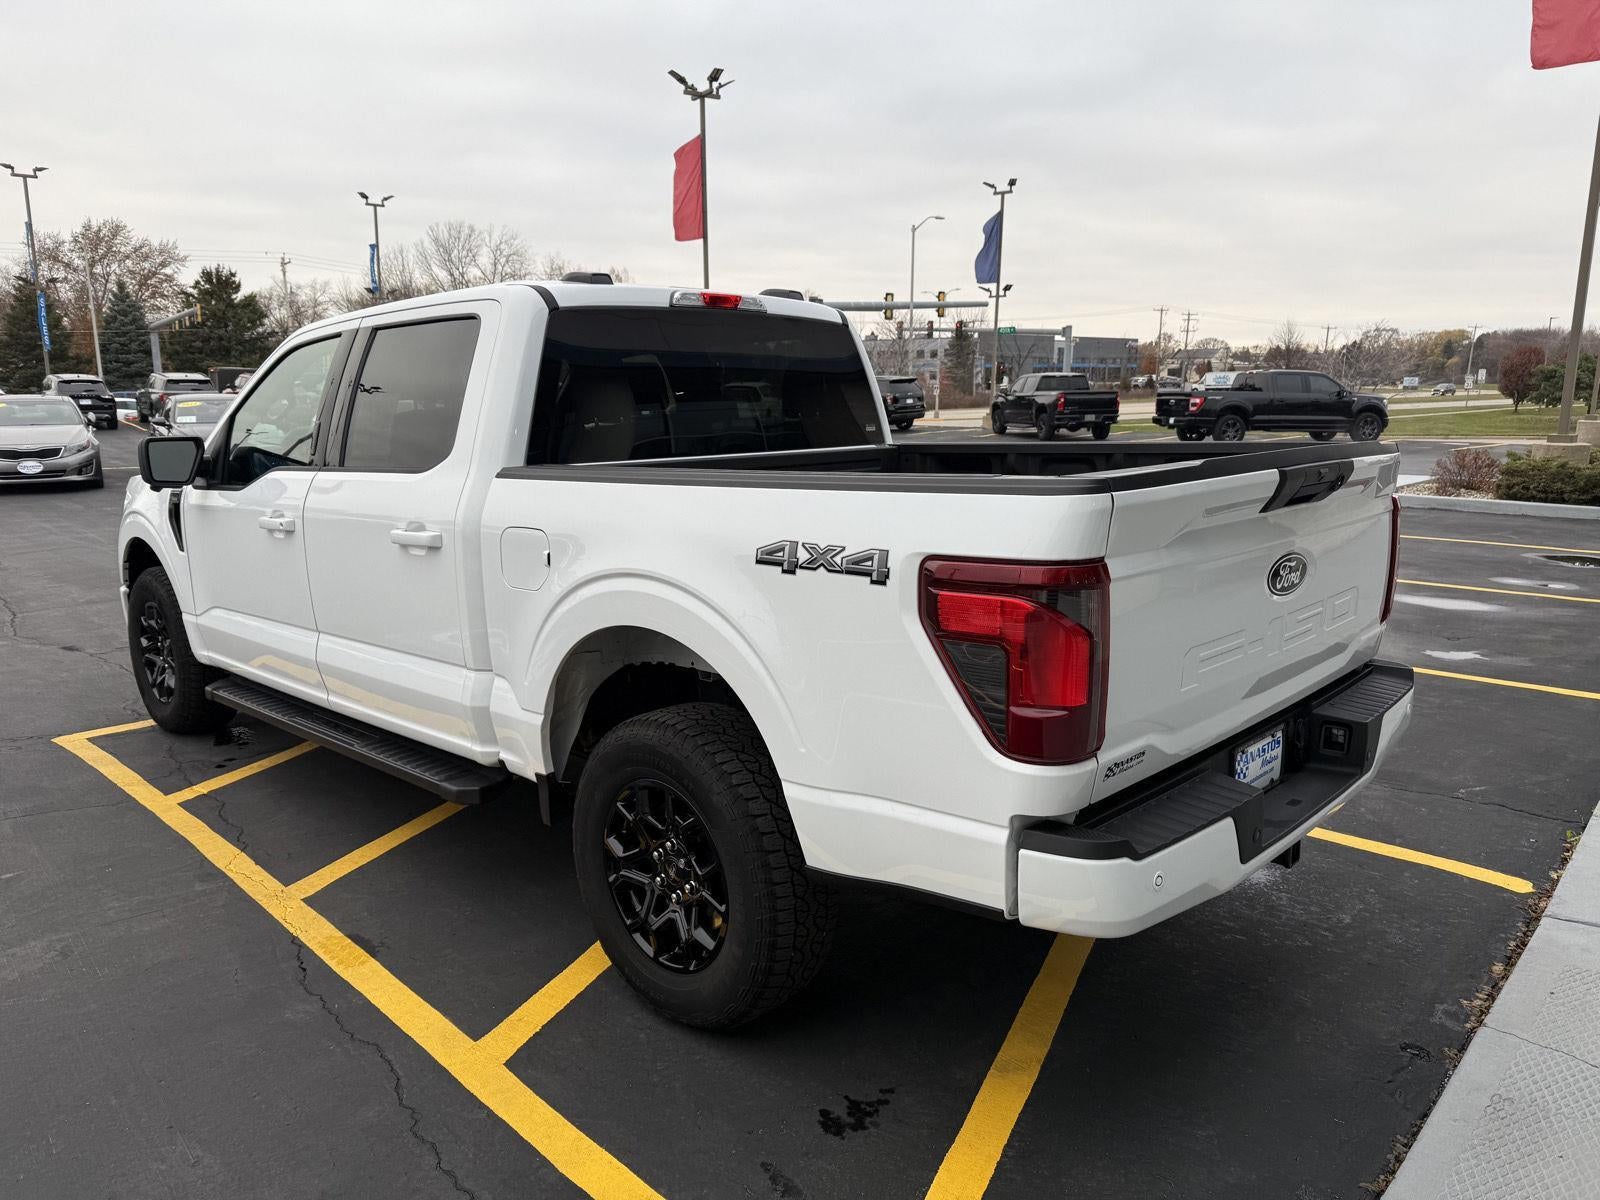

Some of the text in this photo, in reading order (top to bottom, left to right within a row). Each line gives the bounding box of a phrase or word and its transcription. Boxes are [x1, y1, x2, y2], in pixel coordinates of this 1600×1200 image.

[40, 298, 49, 345] SALES
[755, 539, 890, 586] 4X4
[1277, 560, 1303, 590] Ford
[1179, 586, 1358, 692] F-150
[1241, 735, 1282, 767] ANASTOS
